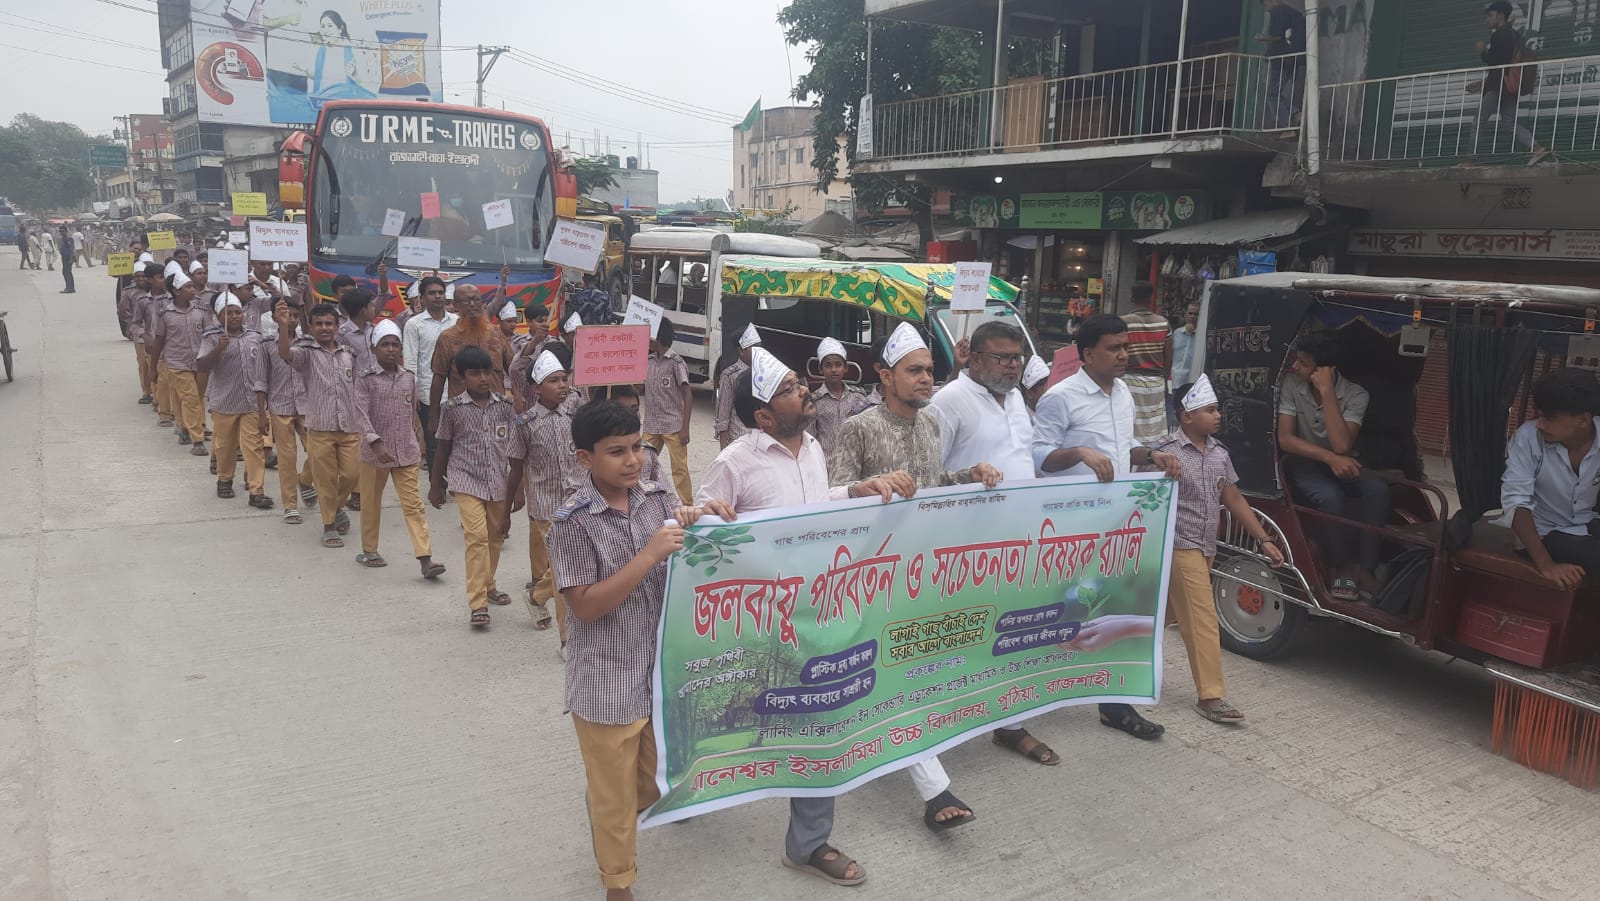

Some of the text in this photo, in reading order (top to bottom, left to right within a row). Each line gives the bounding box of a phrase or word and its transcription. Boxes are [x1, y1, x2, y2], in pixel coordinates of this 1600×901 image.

[360, 113, 516, 150] URME TRAVELS
[1043, 501, 1064, 512] গাছের
[1065, 499, 1082, 511] প্রতি
[1097, 498, 1112, 508] নিন
[774, 524, 870, 547] গাছ পরিবেশের প্রাণ
[692, 570, 806, 652] জলবায়ু
[809, 533, 902, 630] পরিবর্তন
[906, 551, 924, 600] ও
[931, 533, 1033, 600] সচেতনতা
[1033, 517, 1101, 590] বিষয়ক
[889, 626, 985, 662] সবার আগে বাংলাদেশ
[890, 610, 990, 644] লাগাই গাছ বাঁচাই দেশ
[997, 635, 1021, 652] পরিবেশ
[1040, 627, 1058, 643] জীবন
[685, 646, 746, 673] সবুজ পৃথিবী
[810, 660, 837, 681] প্লাস্টিক
[715, 668, 758, 686] অঙ্গীকার
[765, 693, 798, 711] বিদ্যুৎ
[800, 690, 842, 708] ব্যবহারে
[862, 676, 873, 692] হন
[758, 722, 793, 740] লার্নিং
[858, 708, 869, 723] ইন
[908, 683, 944, 704] এডুকেশন
[1000, 666, 1006, 676] ও
[787, 735, 887, 779] ইসলামিয়া
[887, 723, 924, 747] উচ্চ
[926, 700, 991, 733] বিদ্যালয়,
[996, 684, 1041, 713] পুঠিয়া,
[1045, 669, 1112, 695] রাজশাহী
